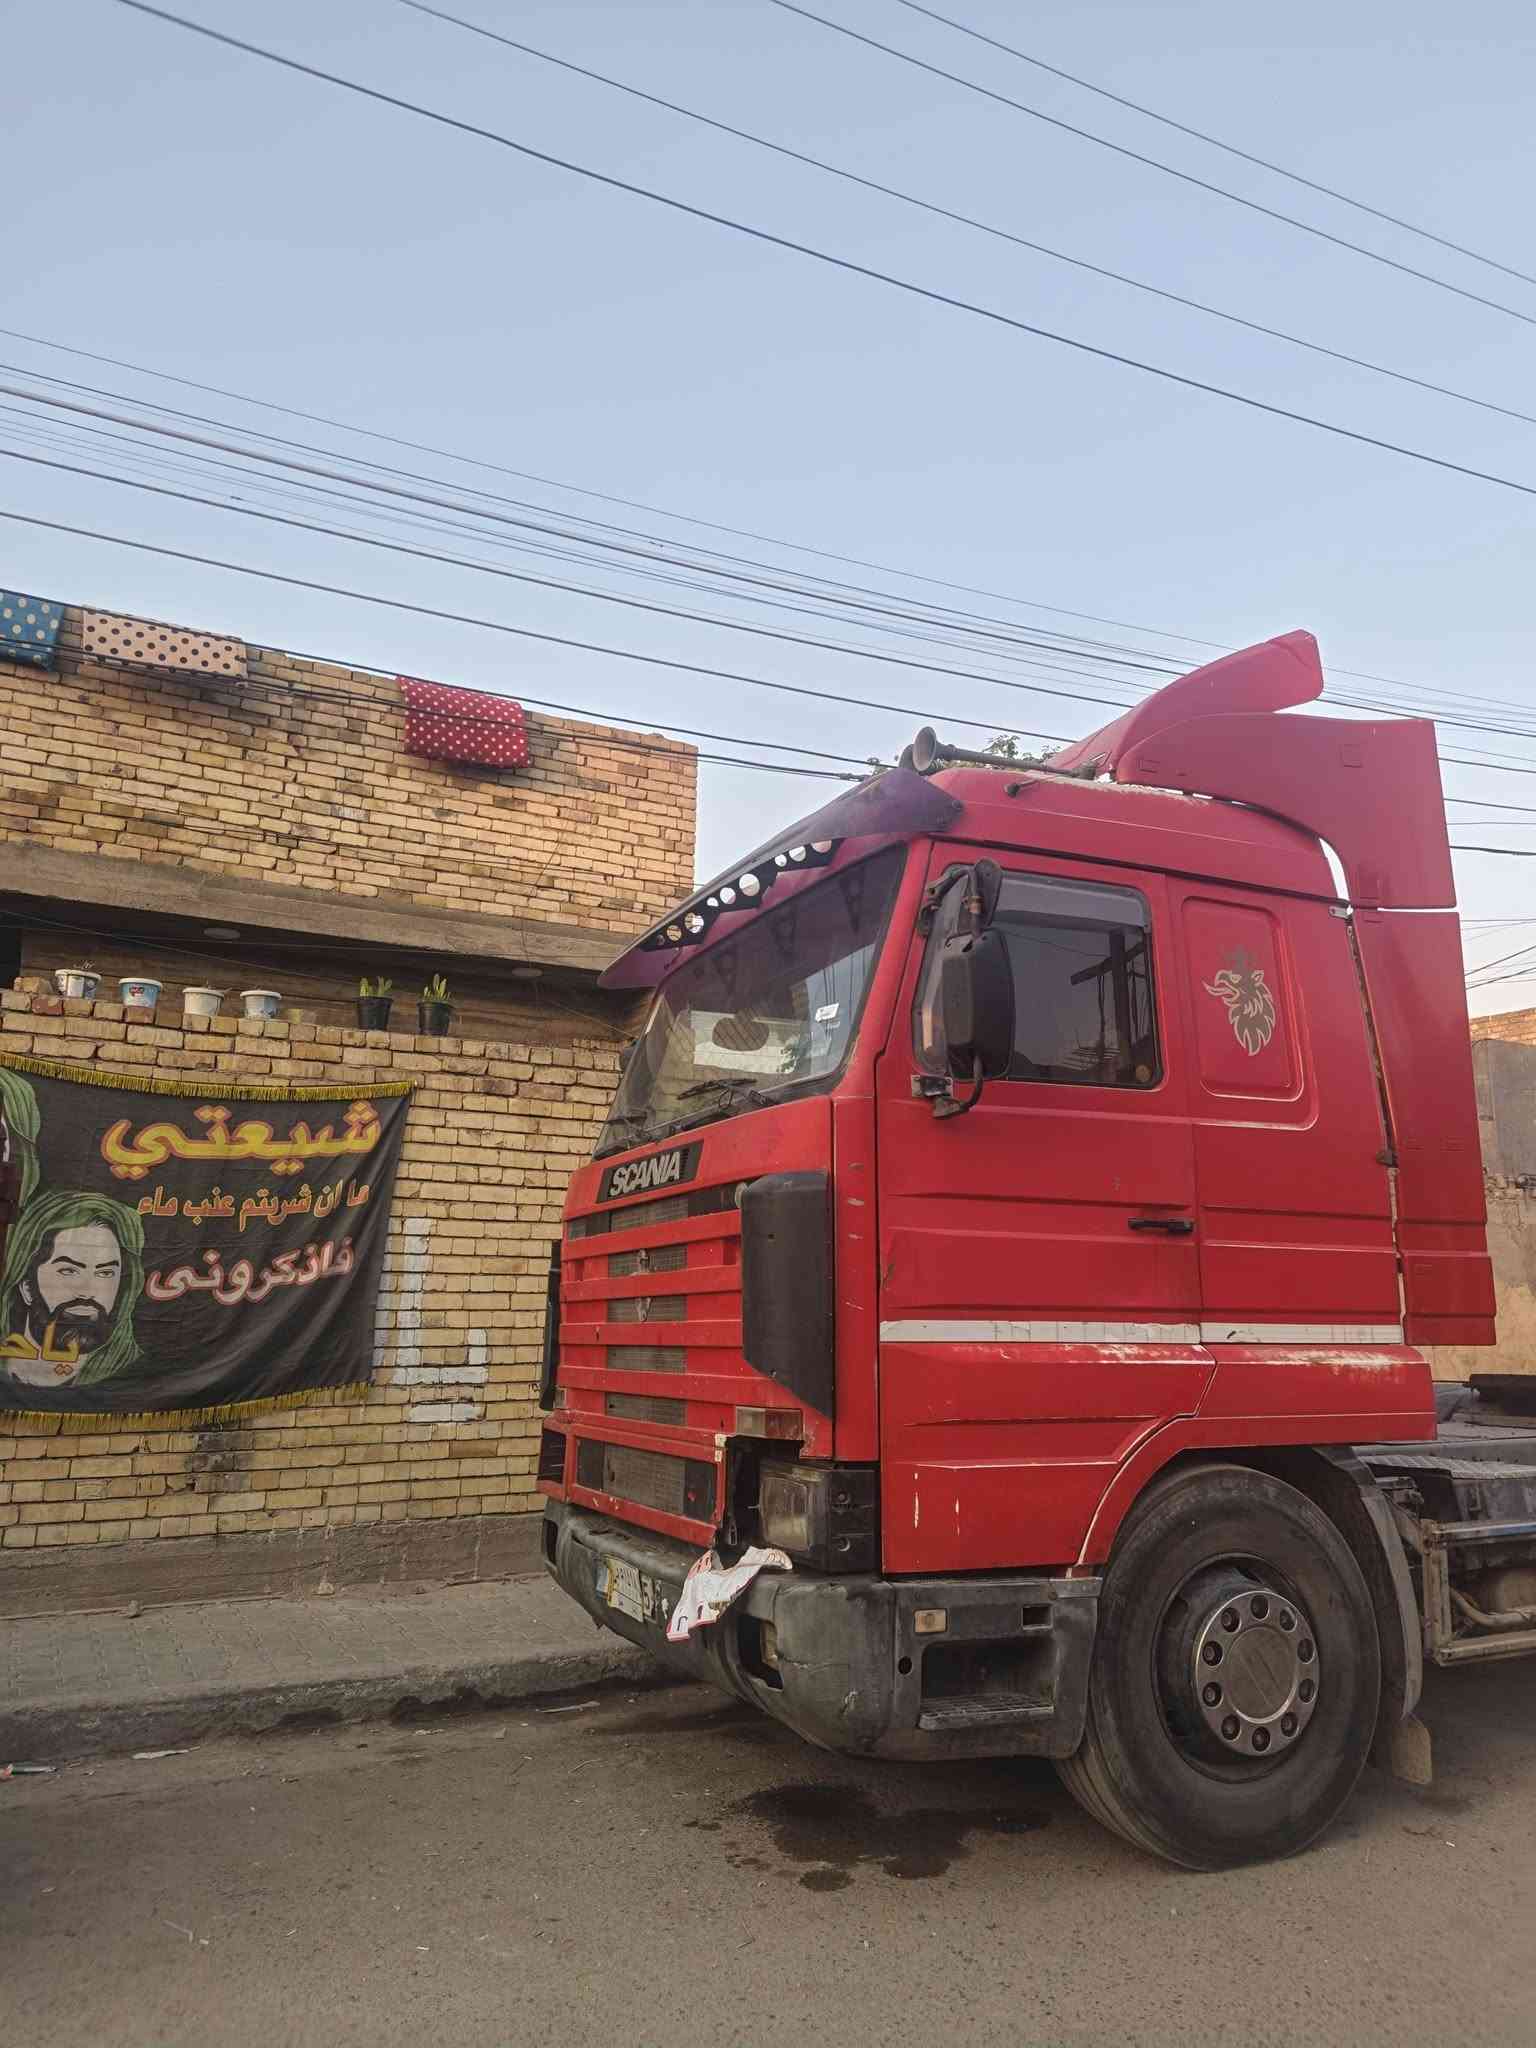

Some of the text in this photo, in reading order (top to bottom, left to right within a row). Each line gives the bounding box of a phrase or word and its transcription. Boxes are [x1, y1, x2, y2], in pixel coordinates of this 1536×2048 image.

[102, 1101, 381, 1180] شيعتي
[346, 1178, 370, 1207] ما
[610, 1151, 681, 1197] SCANIA
[137, 1185, 178, 1216] ماء
[41, 1319, 80, 1377] يا
